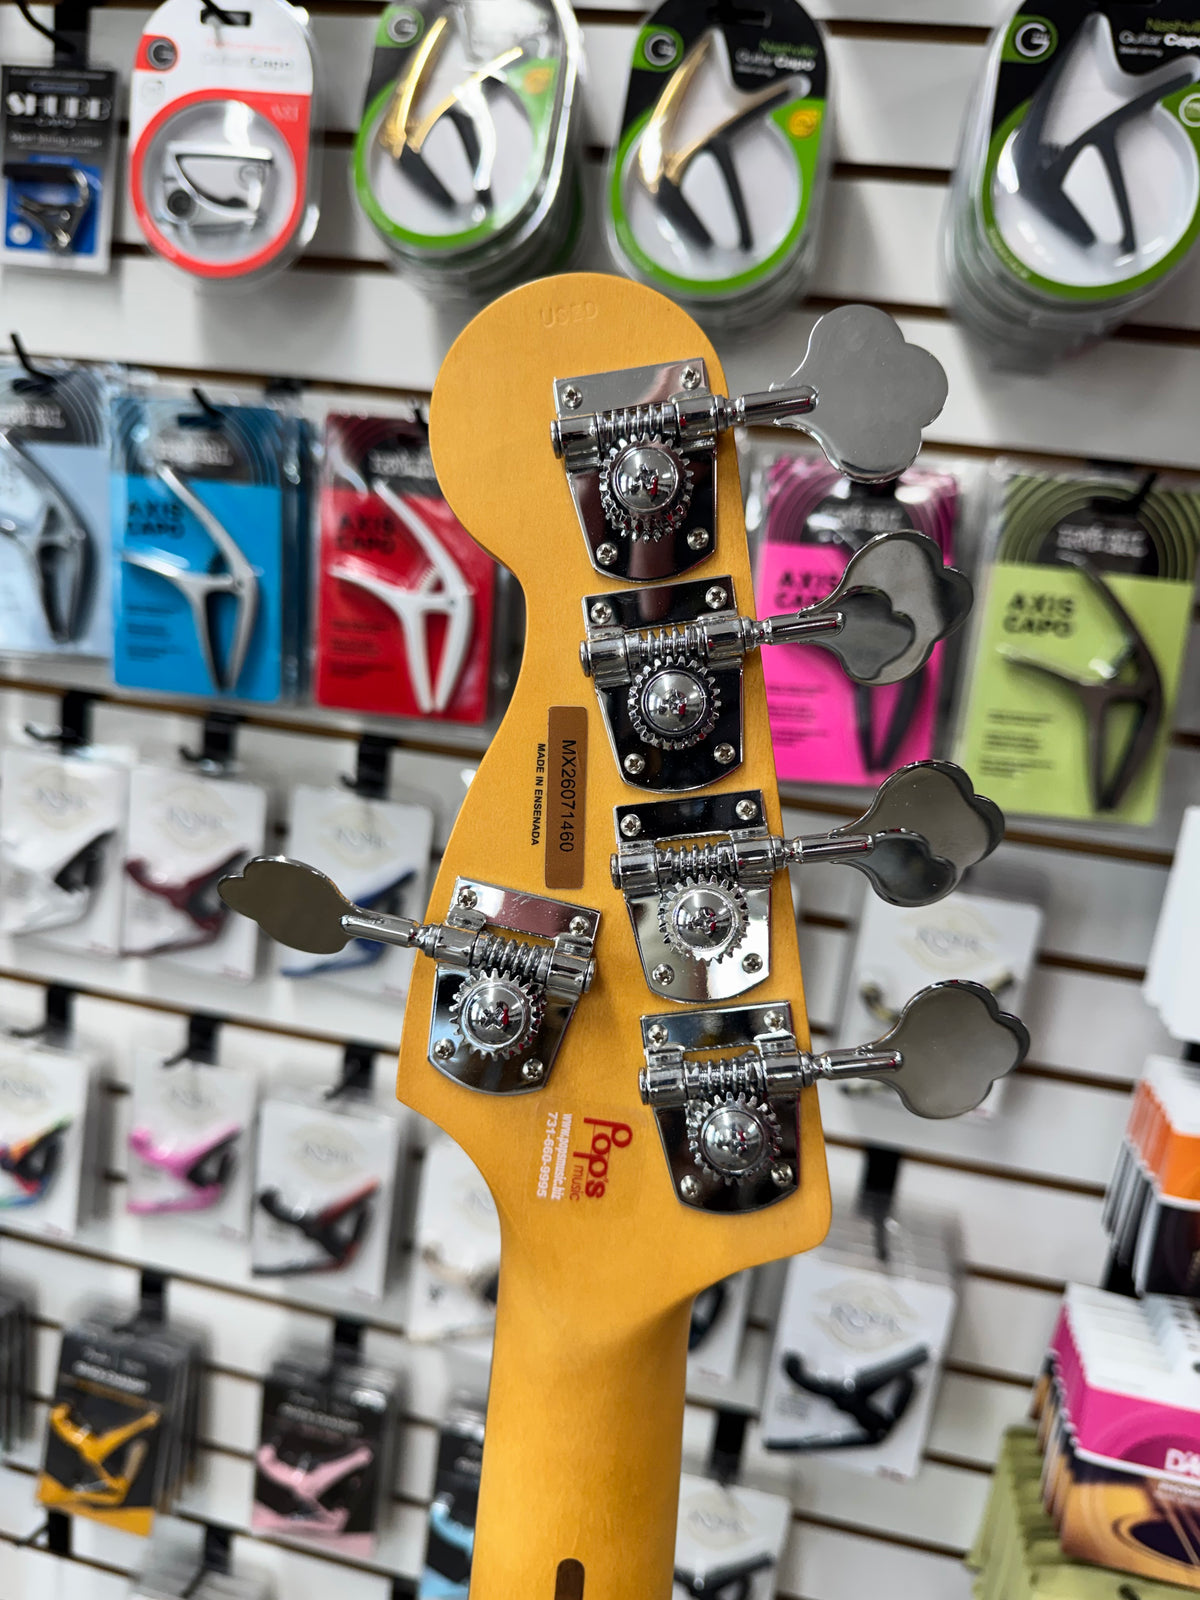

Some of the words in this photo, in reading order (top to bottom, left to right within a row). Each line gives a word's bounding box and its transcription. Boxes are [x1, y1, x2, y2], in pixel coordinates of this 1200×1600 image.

[1006, 592, 1075, 617] AXIS
[1001, 615, 1074, 639] CAPO
[536, 743, 546, 773] MADE
[535, 776, 544, 786] IN
[559, 739, 577, 853] MX26071460
[531, 789, 543, 846] ENSENADA
[536, 1111, 559, 1199] 731-660-9995
[551, 1113, 573, 1201] www.popsmusic.biz
[569, 1164, 585, 1201] music
